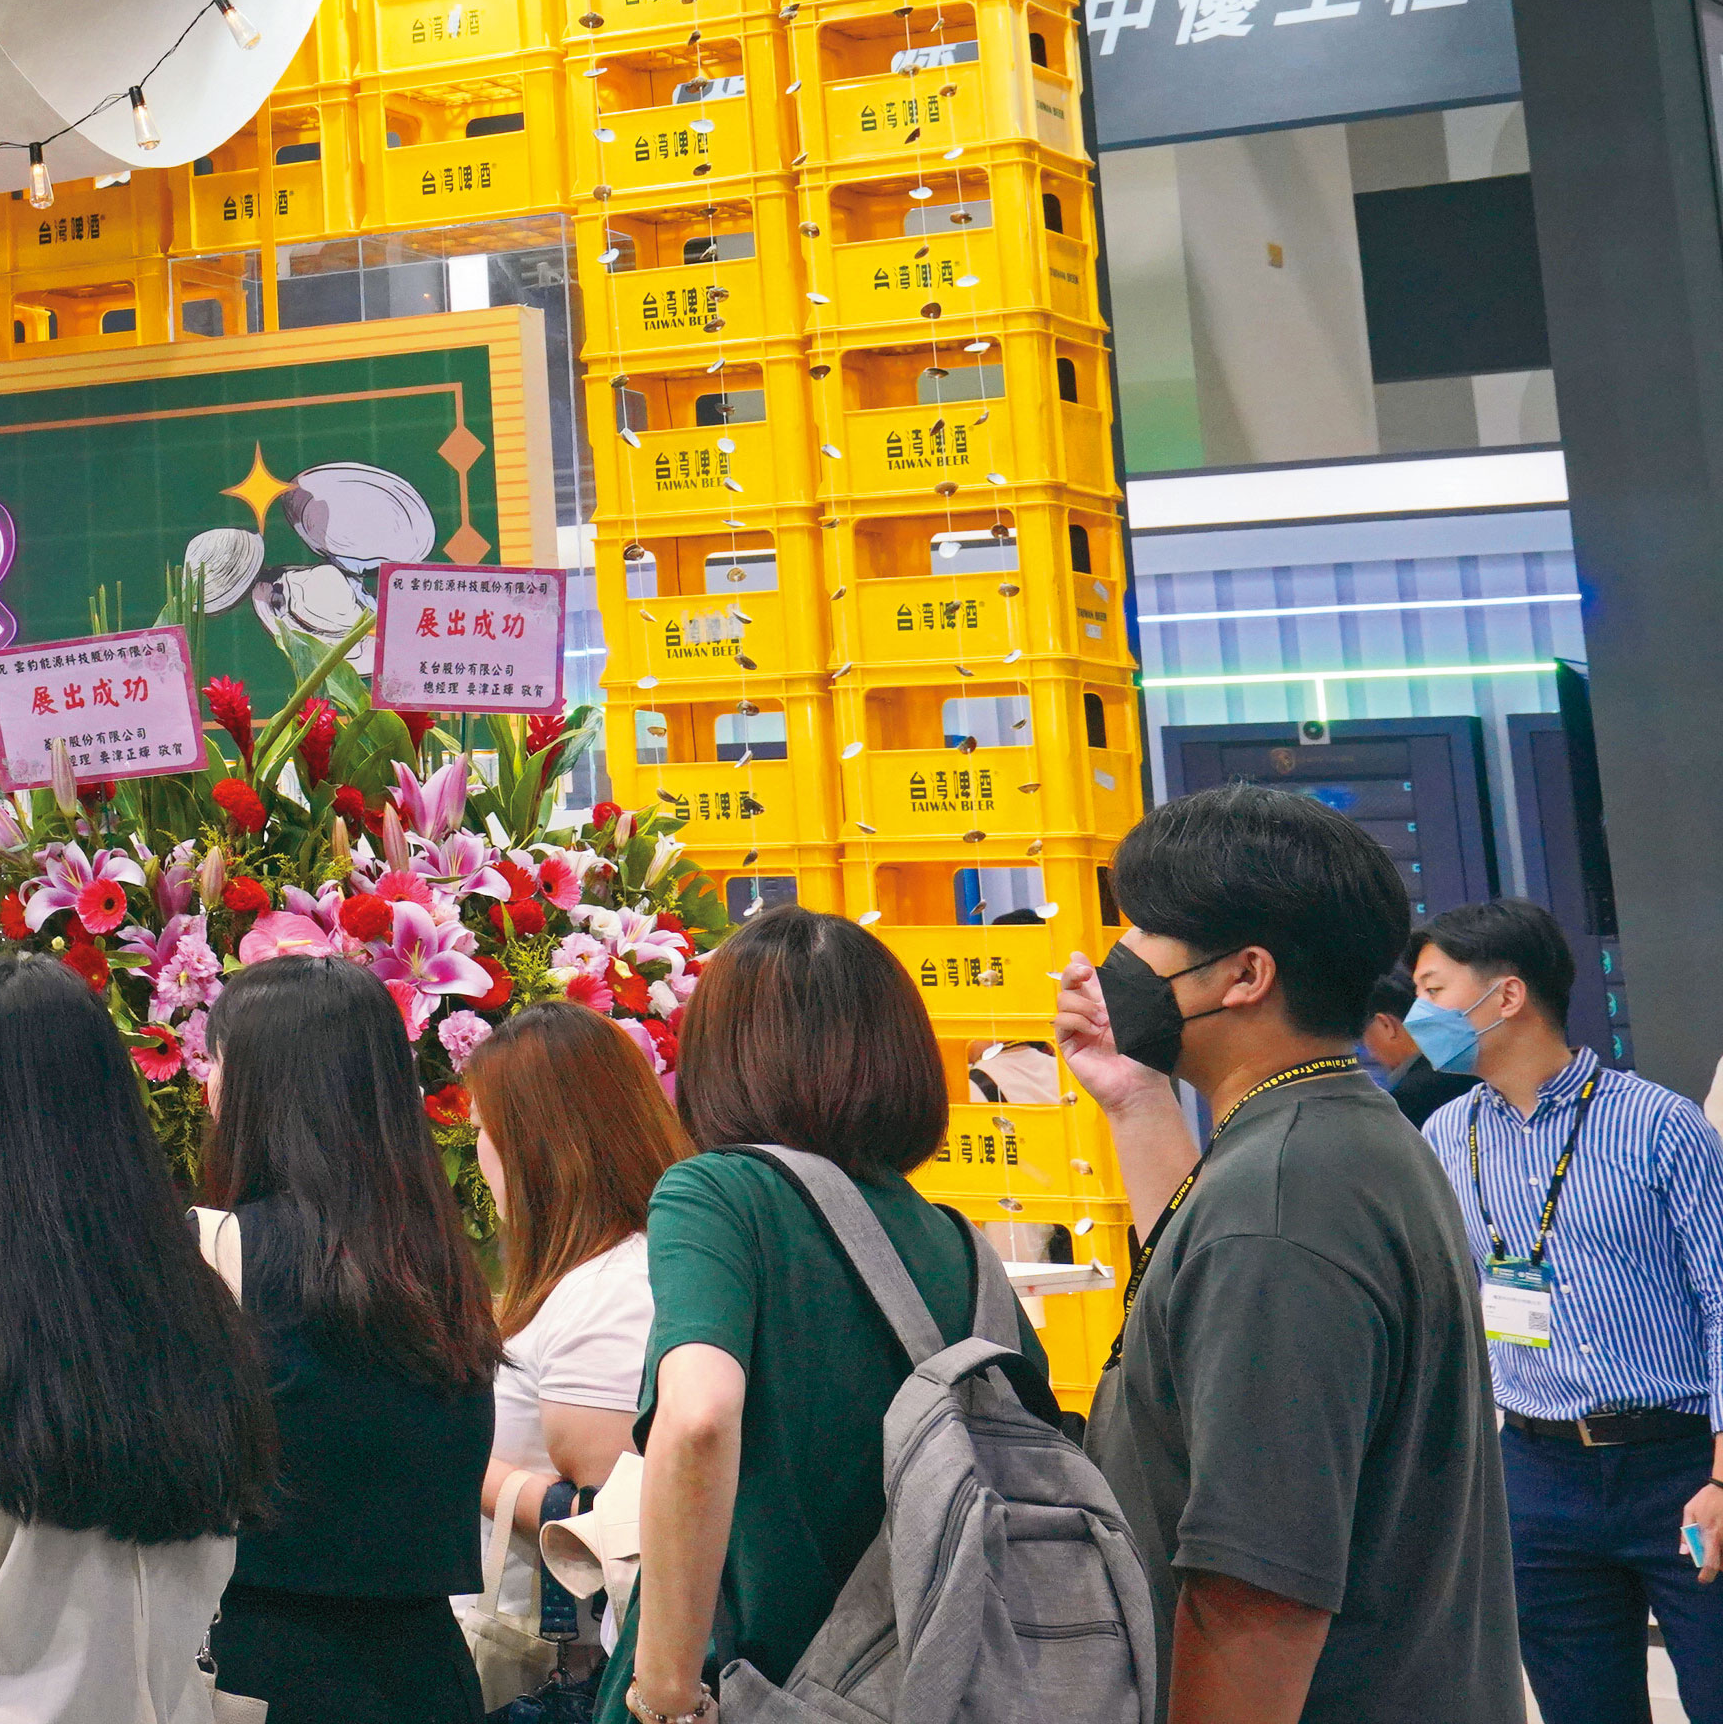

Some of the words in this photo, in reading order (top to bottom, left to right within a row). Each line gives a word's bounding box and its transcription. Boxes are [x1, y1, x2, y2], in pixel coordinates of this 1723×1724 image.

[643, 319, 685, 331] TAIWAN
[886, 457, 932, 471] TAIWAN
[936, 454, 970, 467] BEER
[655, 479, 698, 492] TAIWAN
[415, 607, 525, 641] 展出成功
[666, 647, 708, 659] TAIWAN
[31, 676, 149, 716] 展出成功
[910, 800, 956, 812] TAIWAN
[960, 798, 995, 812] BEER
